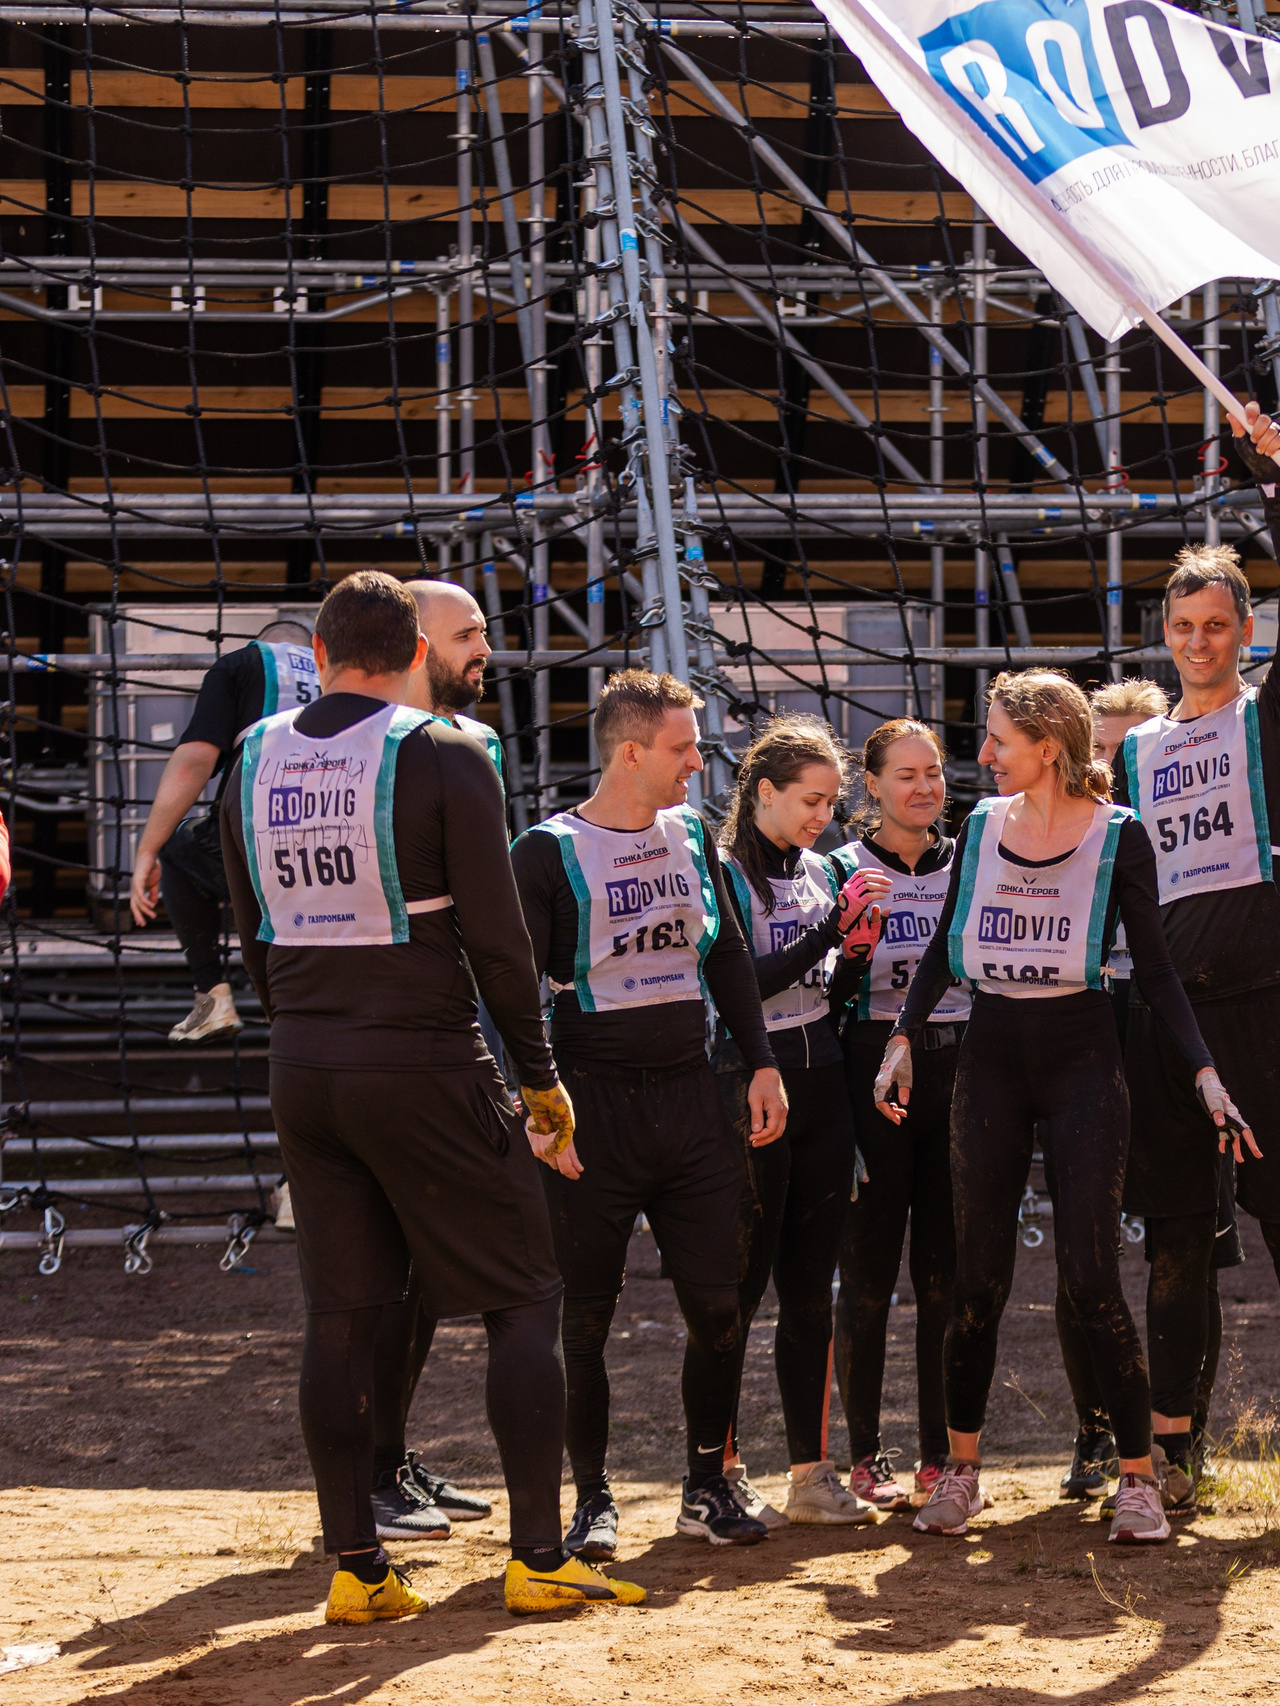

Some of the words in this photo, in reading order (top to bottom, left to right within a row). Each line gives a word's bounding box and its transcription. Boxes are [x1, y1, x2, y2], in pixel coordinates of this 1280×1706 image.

[1155, 753, 1230, 797] RODVIG
[270, 788, 356, 823] RODVIG
[1156, 801, 1234, 853] 5164
[274, 845, 357, 889] 5160
[613, 853, 642, 866] ГОНКА
[1182, 862, 1230, 879] ГАЗПРОМБАНК
[609, 872, 690, 914] RODVIG
[893, 892, 919, 900] ГОНКА
[920, 892, 947, 900] ГЕРОЕ
[996, 884, 1024, 894] ГОНКА
[1026, 887, 1060, 896] ГЕРОЕВ
[307, 912, 357, 925] ГАЗПРОМБАНК
[980, 911, 1071, 942] RODVIG
[640, 972, 686, 986] ГАЗПРОМБАНК
